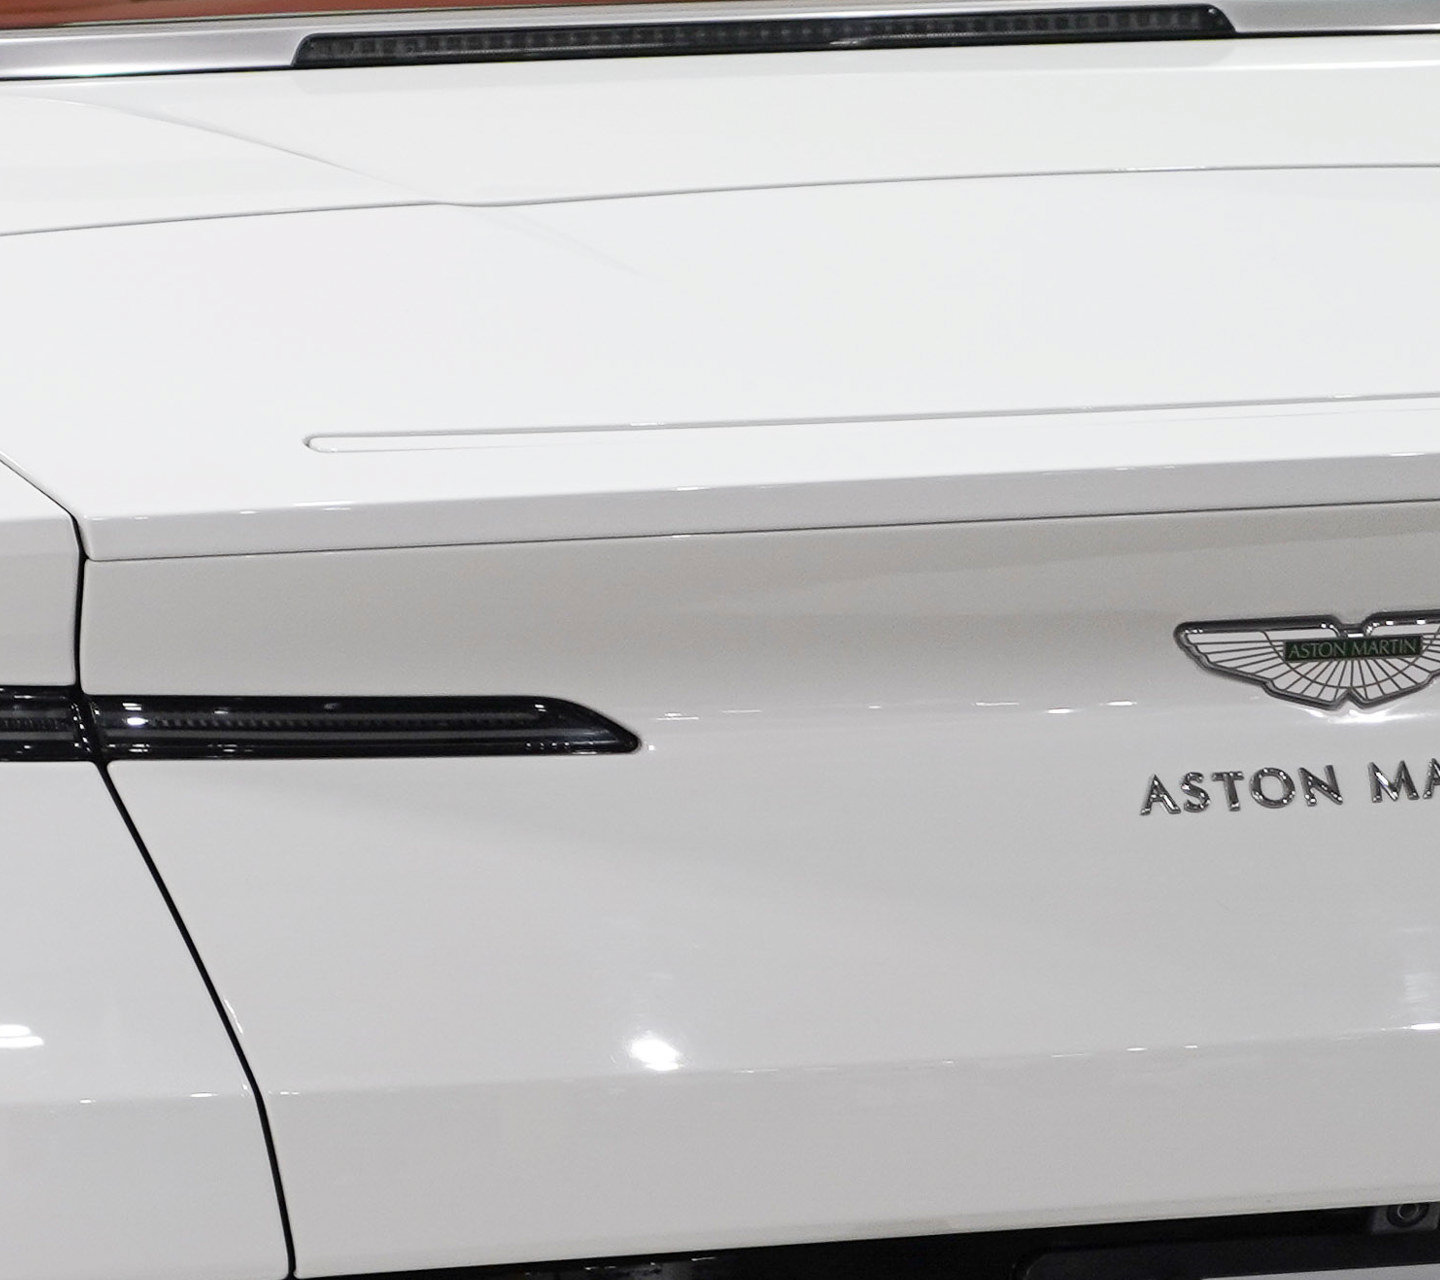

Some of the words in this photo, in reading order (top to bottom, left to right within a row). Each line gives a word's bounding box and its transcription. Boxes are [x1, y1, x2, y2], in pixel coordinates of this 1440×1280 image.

[1288, 643, 1347, 660] ASTON
[1350, 637, 1418, 656] MARTIN
[1140, 764, 1344, 816] ASTON
